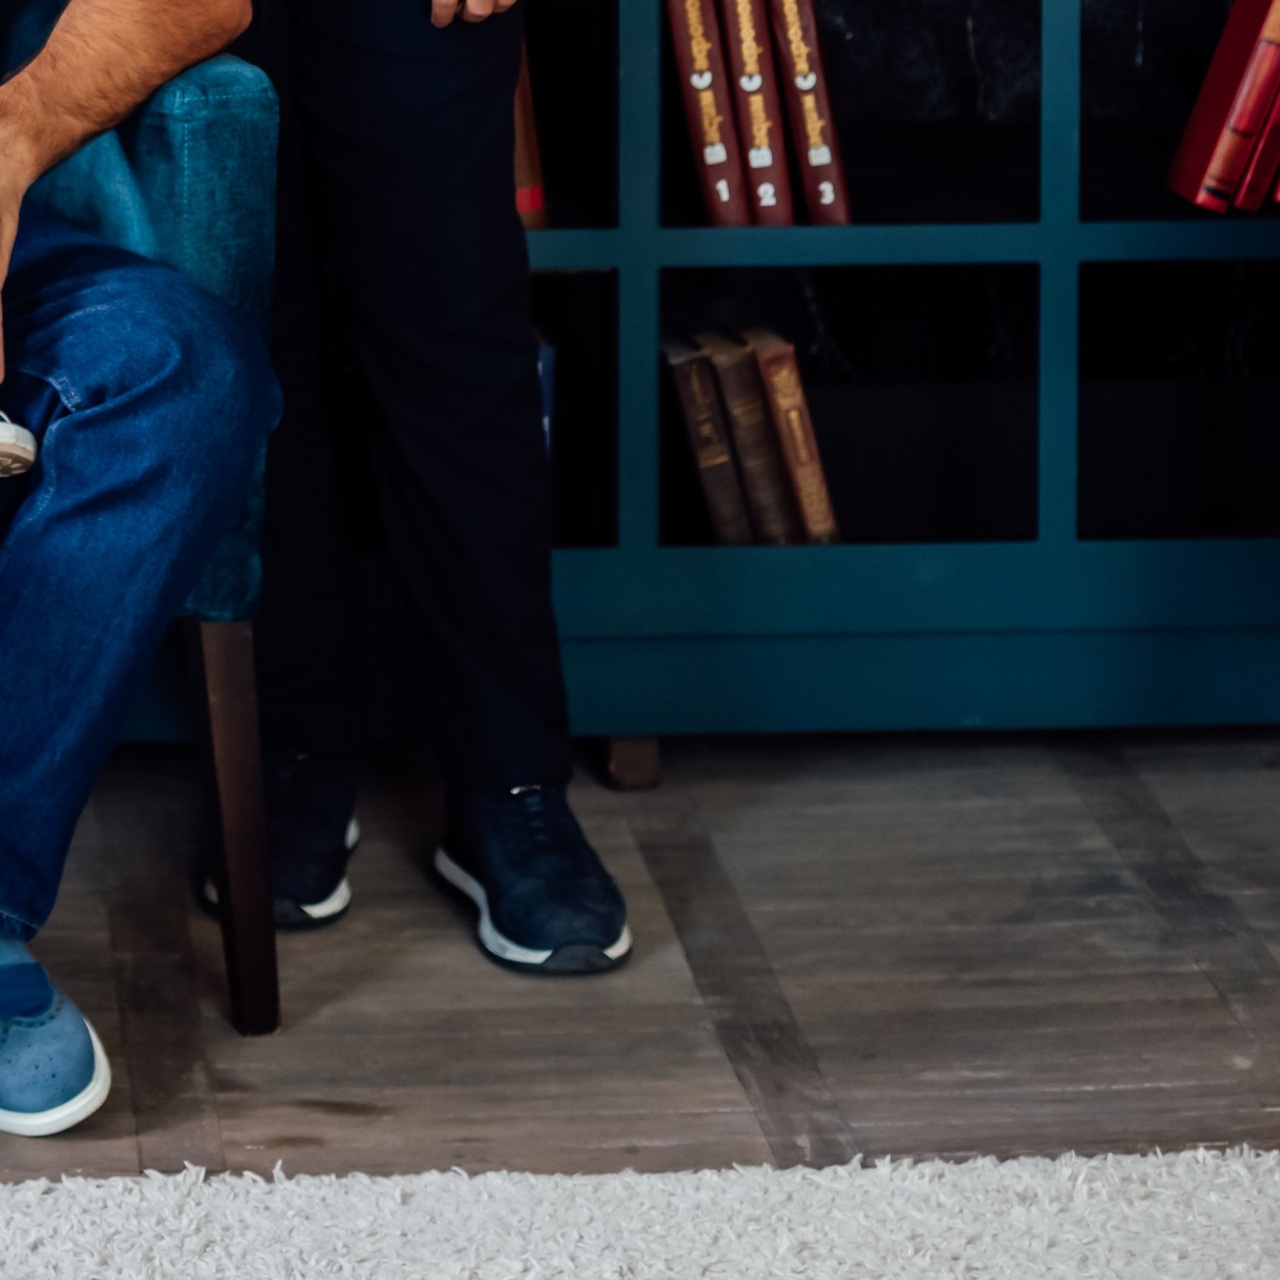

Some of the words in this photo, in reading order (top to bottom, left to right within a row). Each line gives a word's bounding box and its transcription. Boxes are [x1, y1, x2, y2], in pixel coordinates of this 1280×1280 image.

[715, 179, 730, 202] 1
[757, 182, 776, 207] 2
[818, 181, 835, 205] 3
